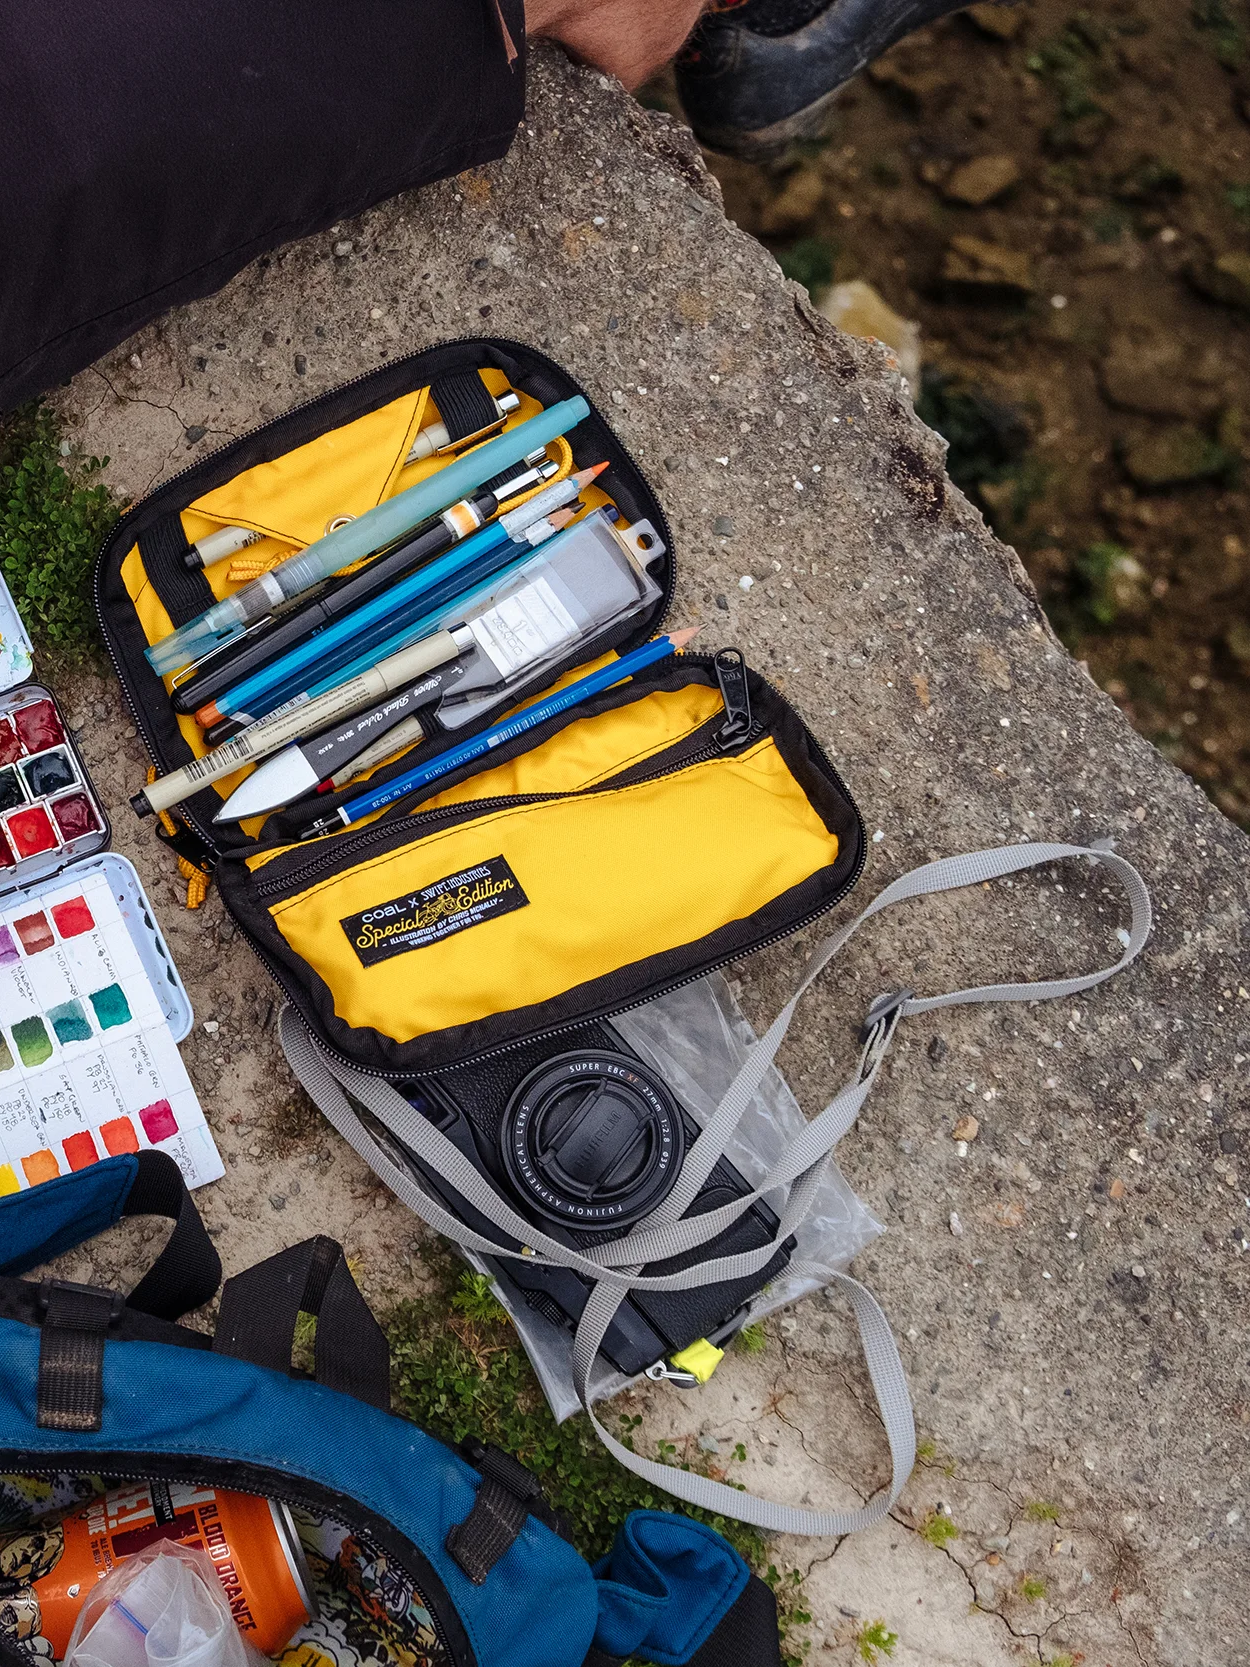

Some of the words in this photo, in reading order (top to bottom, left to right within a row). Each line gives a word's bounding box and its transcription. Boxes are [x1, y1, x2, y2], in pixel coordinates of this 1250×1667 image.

[384, 695, 410, 716] Black
[357, 712, 383, 732] Velvet
[472, 744, 484, 754] EAN
[391, 789, 401, 797] Nr.
[402, 782, 412, 792] Art.
[449, 866, 491, 889] INDUSTRIES
[356, 909, 424, 948] Special
[456, 877, 514, 910] Edition
[390, 925, 436, 945] ILLUSTRATION
[437, 920, 448, 929] BY
[448, 911, 470, 924] CHRIS
[433, 924, 461, 939] TOGETHER
[569, 1063, 600, 1073] SUPER
[608, 1065, 625, 1076] EBC
[627, 1074, 639, 1084] XF
[642, 1087, 662, 1112] 27mm
[661, 1119, 670, 1143] 1:2.8
[517, 1105, 529, 1134] LENS
[516, 1142, 561, 1207] ASPHERICAL
[568, 1205, 622, 1216] FUJINON
[198, 1504, 231, 1561] BLOOD
[216, 1561, 258, 1632] ORANGE
